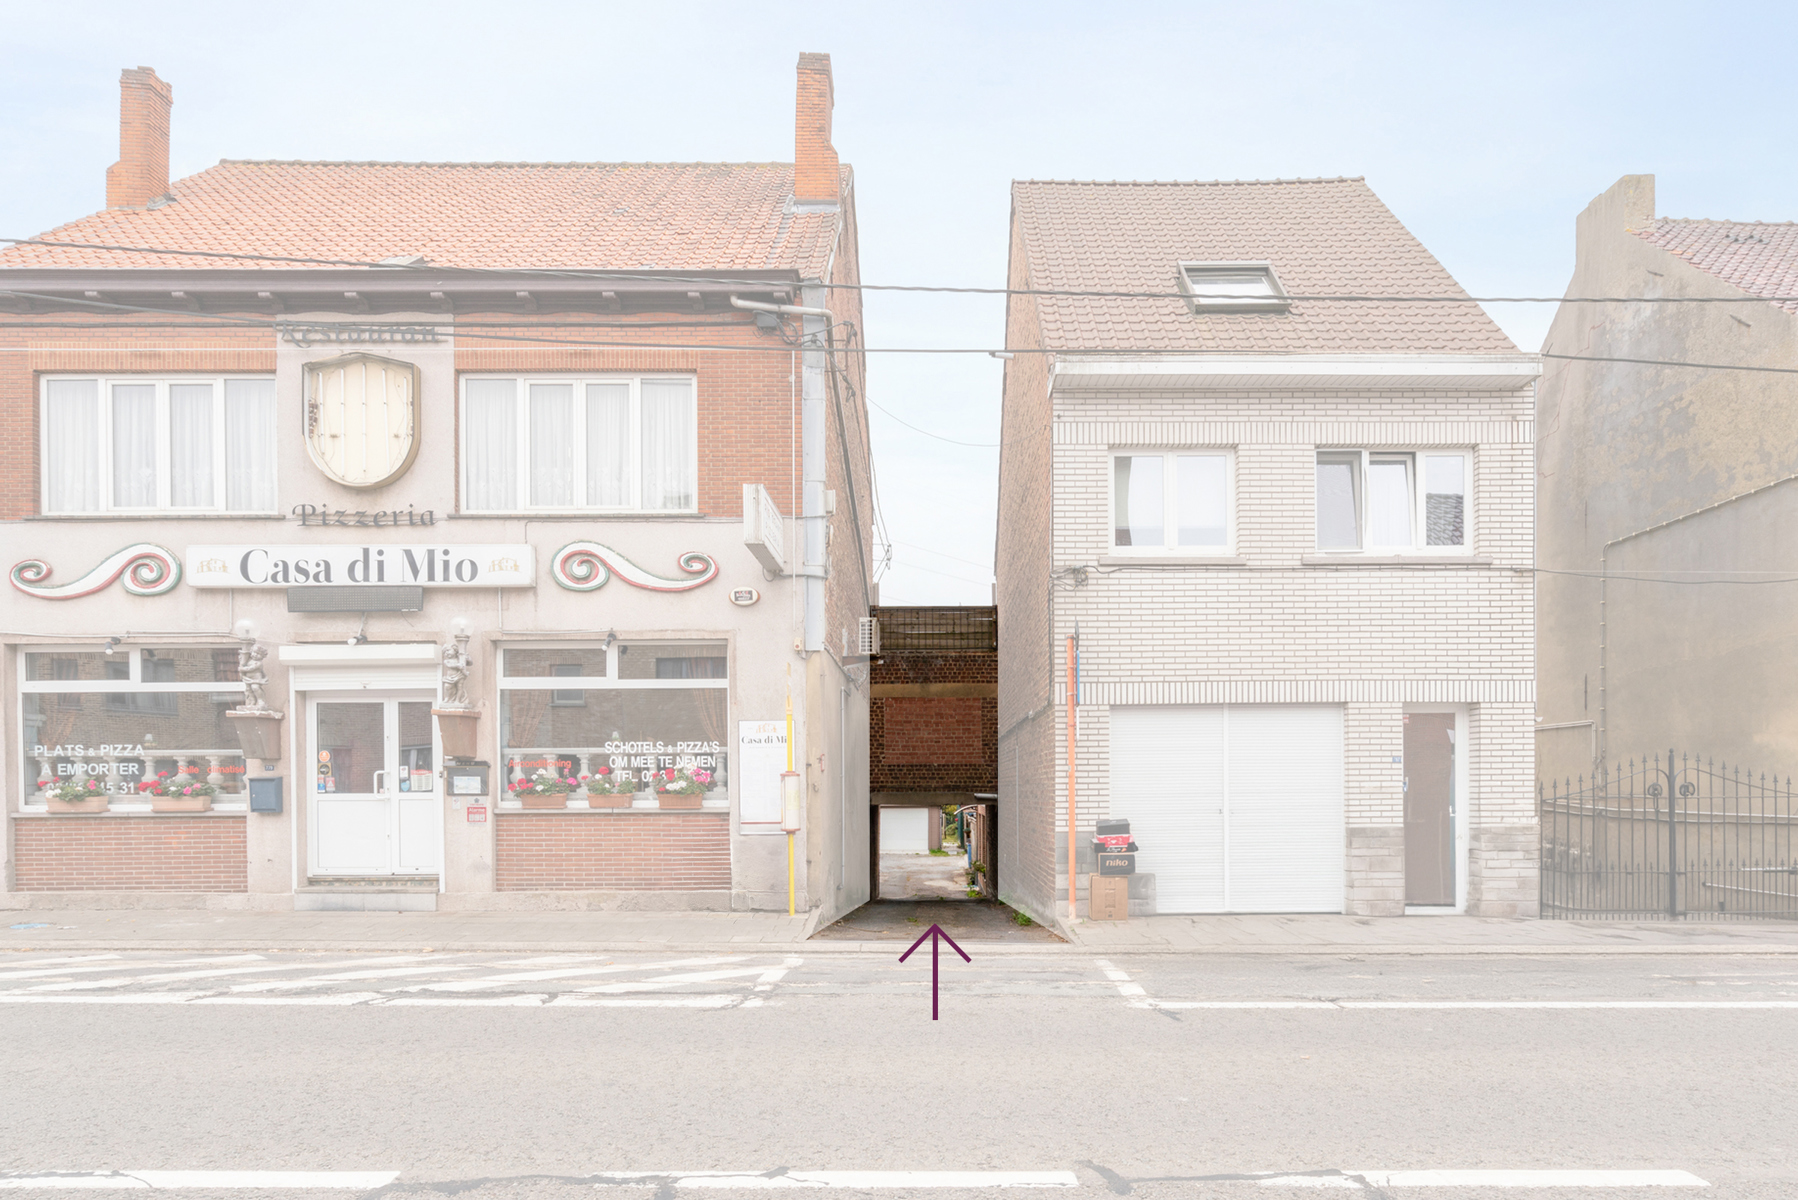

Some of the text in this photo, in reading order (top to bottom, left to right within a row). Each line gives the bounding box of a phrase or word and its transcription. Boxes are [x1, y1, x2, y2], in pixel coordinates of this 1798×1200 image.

[292, 503, 438, 527] Pizzeria
[239, 547, 478, 584] Casa di Mio
[741, 735, 762, 744] Casa
[764, 735, 773, 744] di
[34, 744, 145, 757] PLATS & PIZZA
[604, 741, 720, 754] SCHOTELS & PIZZA'S
[508, 759, 572, 769] Airconditioning
[609, 756, 716, 768] OM MEE TE NEMEN
[41, 763, 139, 775] A EMPORTER
[178, 764, 245, 774] Salle climatisé
[120, 781, 135, 795] 31
[1106, 858, 1128, 867] niko
